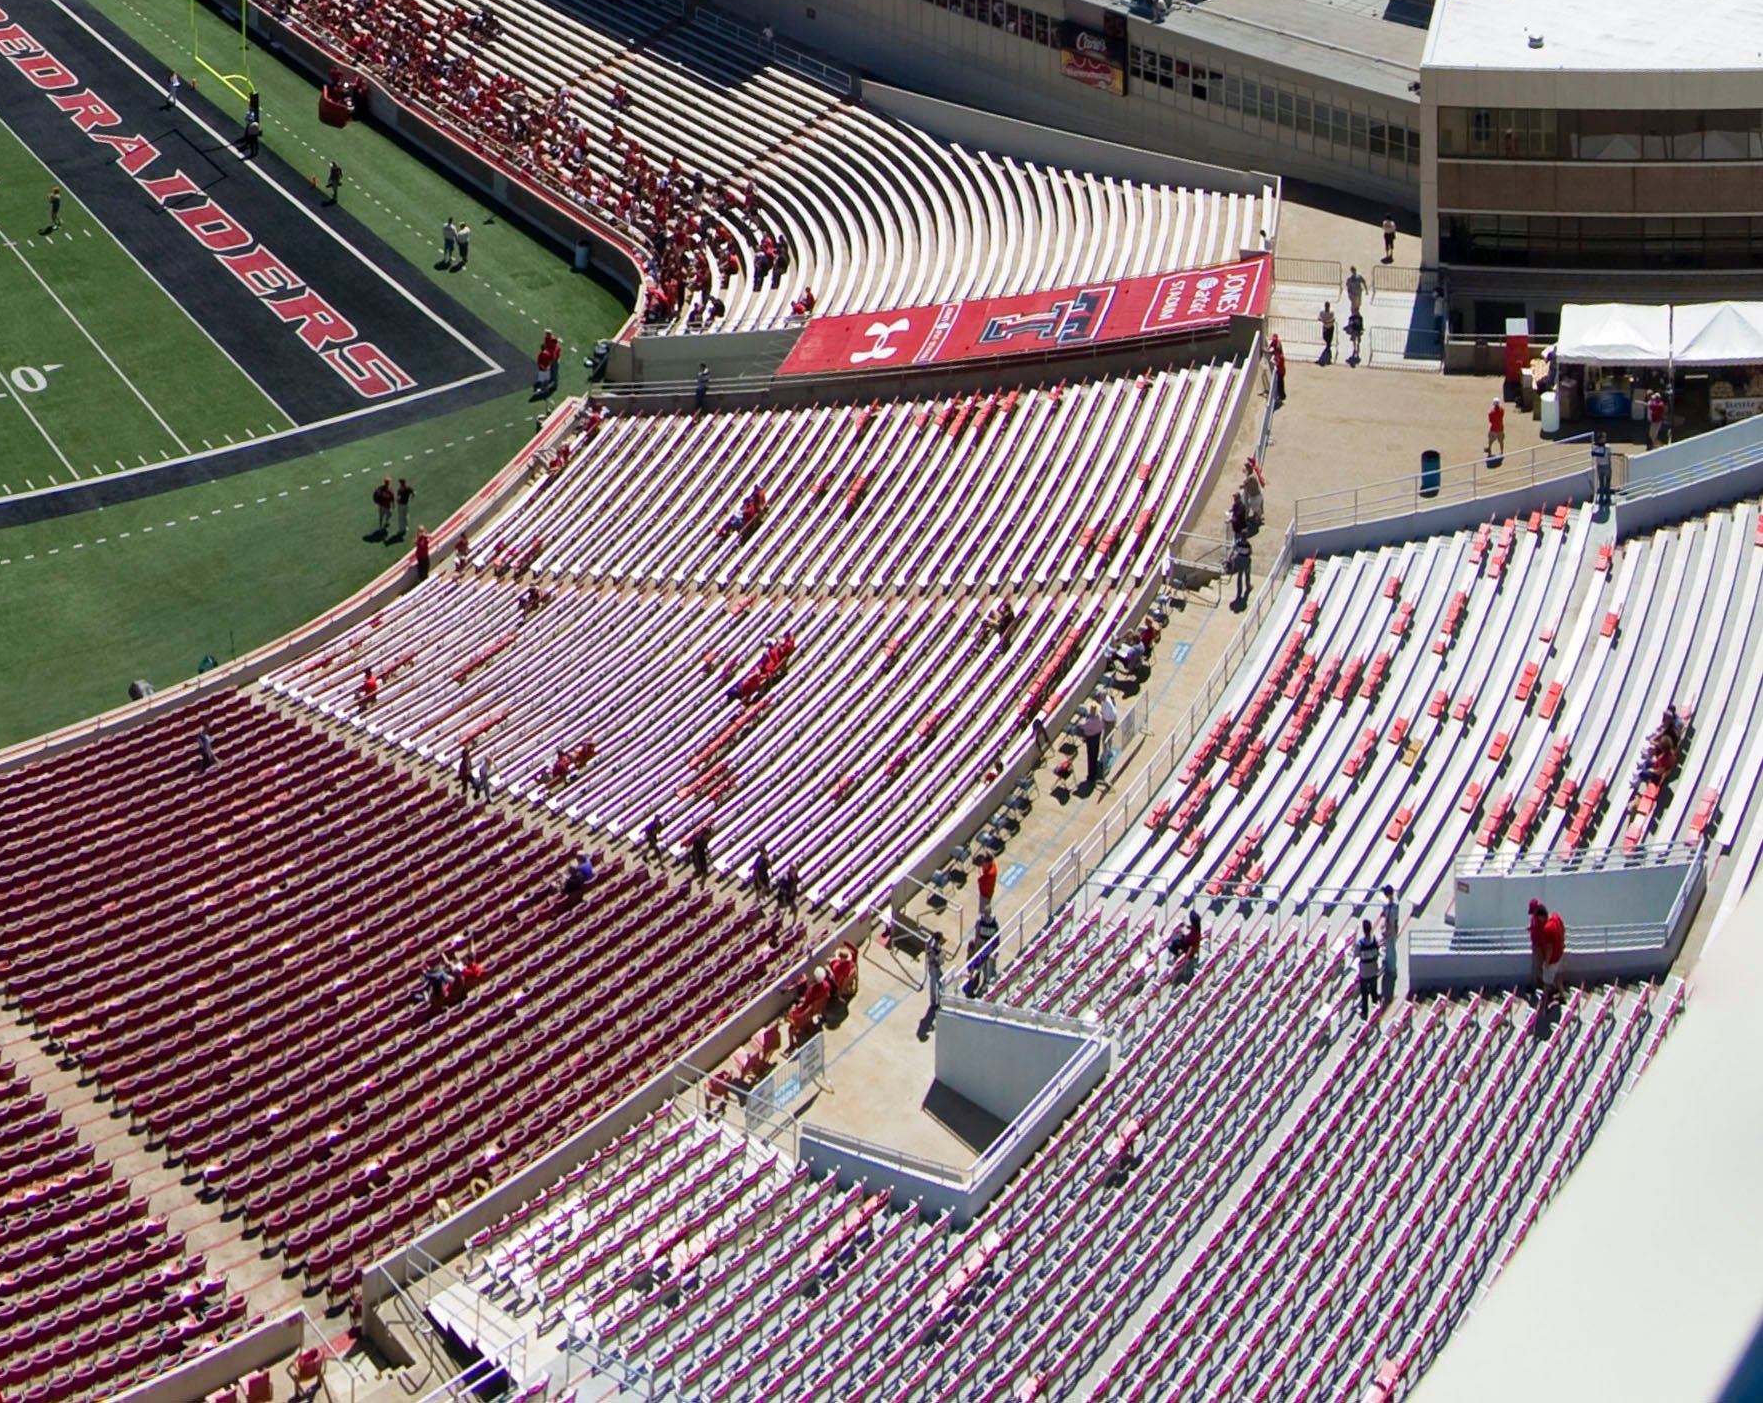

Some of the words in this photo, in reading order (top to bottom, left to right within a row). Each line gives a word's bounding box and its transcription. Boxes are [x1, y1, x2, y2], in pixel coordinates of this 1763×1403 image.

[45, 88, 419, 400] RAIDERS
[1158, 280, 1186, 321] STADIUM
[1216, 273, 1248, 314] JONES
